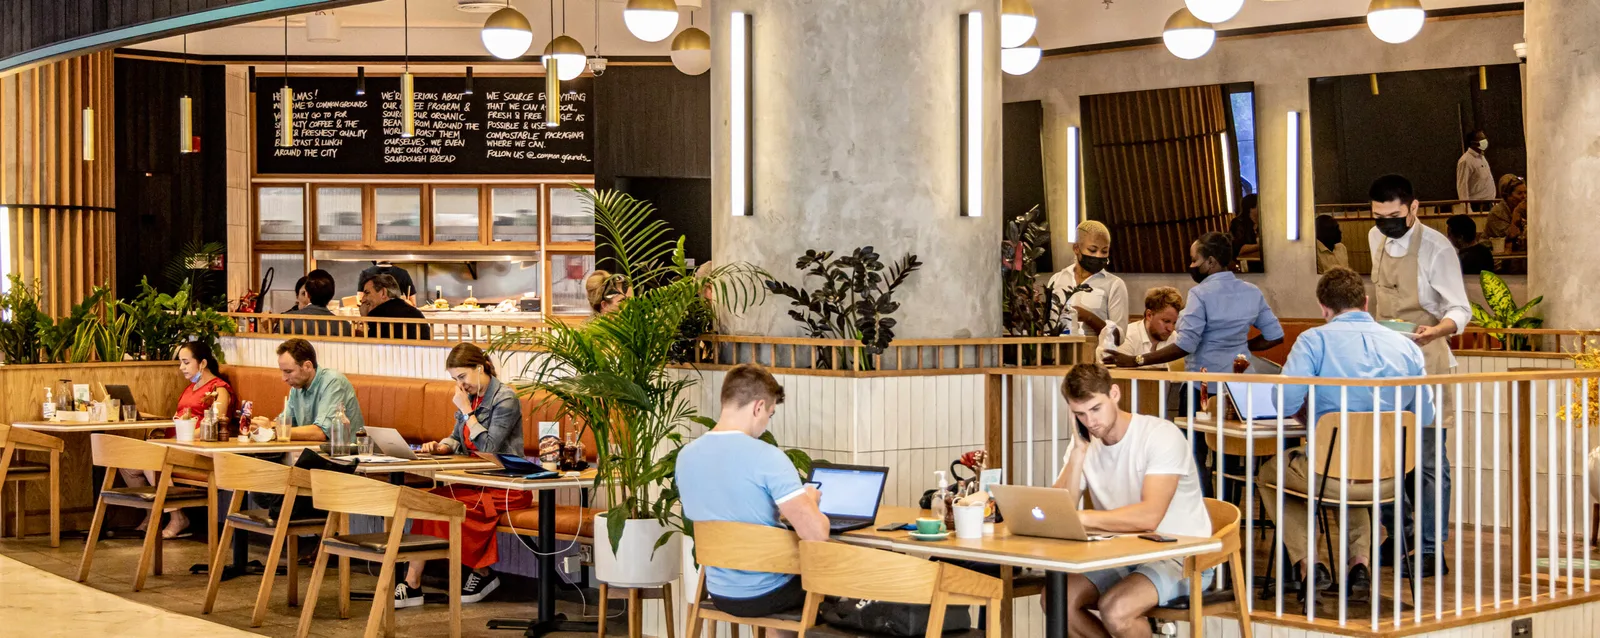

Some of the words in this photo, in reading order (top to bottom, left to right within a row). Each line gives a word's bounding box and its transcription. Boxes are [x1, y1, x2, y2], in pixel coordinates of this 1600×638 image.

[381, 90, 402, 101] WE'R
[413, 92, 438, 101] ERIOUS
[441, 92, 465, 101] ABOUT
[486, 91, 500, 101] WE
[503, 92, 534, 101] SOURCE
[340, 100, 368, 109] GROUNDS
[382, 102, 398, 110] OUR
[427, 102, 461, 111] PROGRAM
[464, 102, 471, 112] &
[486, 102, 506, 110] THAT
[509, 102, 520, 110] WE
[522, 103, 538, 111] CAN
[334, 111, 348, 119] FOR
[430, 111, 466, 121] ORGANIC
[487, 111, 512, 120] FRESH
[515, 111, 520, 119] &
[308, 120, 335, 128] COFFEE
[336, 119, 342, 128] &
[344, 120, 360, 128] THE
[383, 119, 402, 127] BEAN
[433, 121, 463, 130] AROUND
[465, 122, 480, 131] THE
[487, 121, 520, 130] POSSIBLE
[522, 121, 529, 130] &
[530, 122, 547, 130] USE
[301, 129, 338, 138] FRESHEST
[339, 129, 367, 139] QUALITY
[415, 128, 437, 137] ROAST
[438, 129, 461, 139] THEM
[486, 131, 541, 140] COMPOSTABLE
[544, 131, 585, 140] PACKAGING
[314, 138, 320, 147] &
[321, 138, 343, 147] LUNCH
[444, 138, 466, 147] EVEN
[486, 140, 513, 148] WHERE
[528, 140, 547, 149] CAN.
[274, 148, 301, 157] AROUND
[303, 149, 318, 157] THE
[320, 148, 337, 158] CITY
[384, 146, 404, 154] BAKE
[405, 146, 422, 154] OUR
[423, 146, 442, 154] OWN
[486, 149, 512, 159] FOLLOW
[513, 150, 525, 159] US
[384, 155, 427, 163] SOURDOUGH
[429, 154, 457, 163] BREAD
